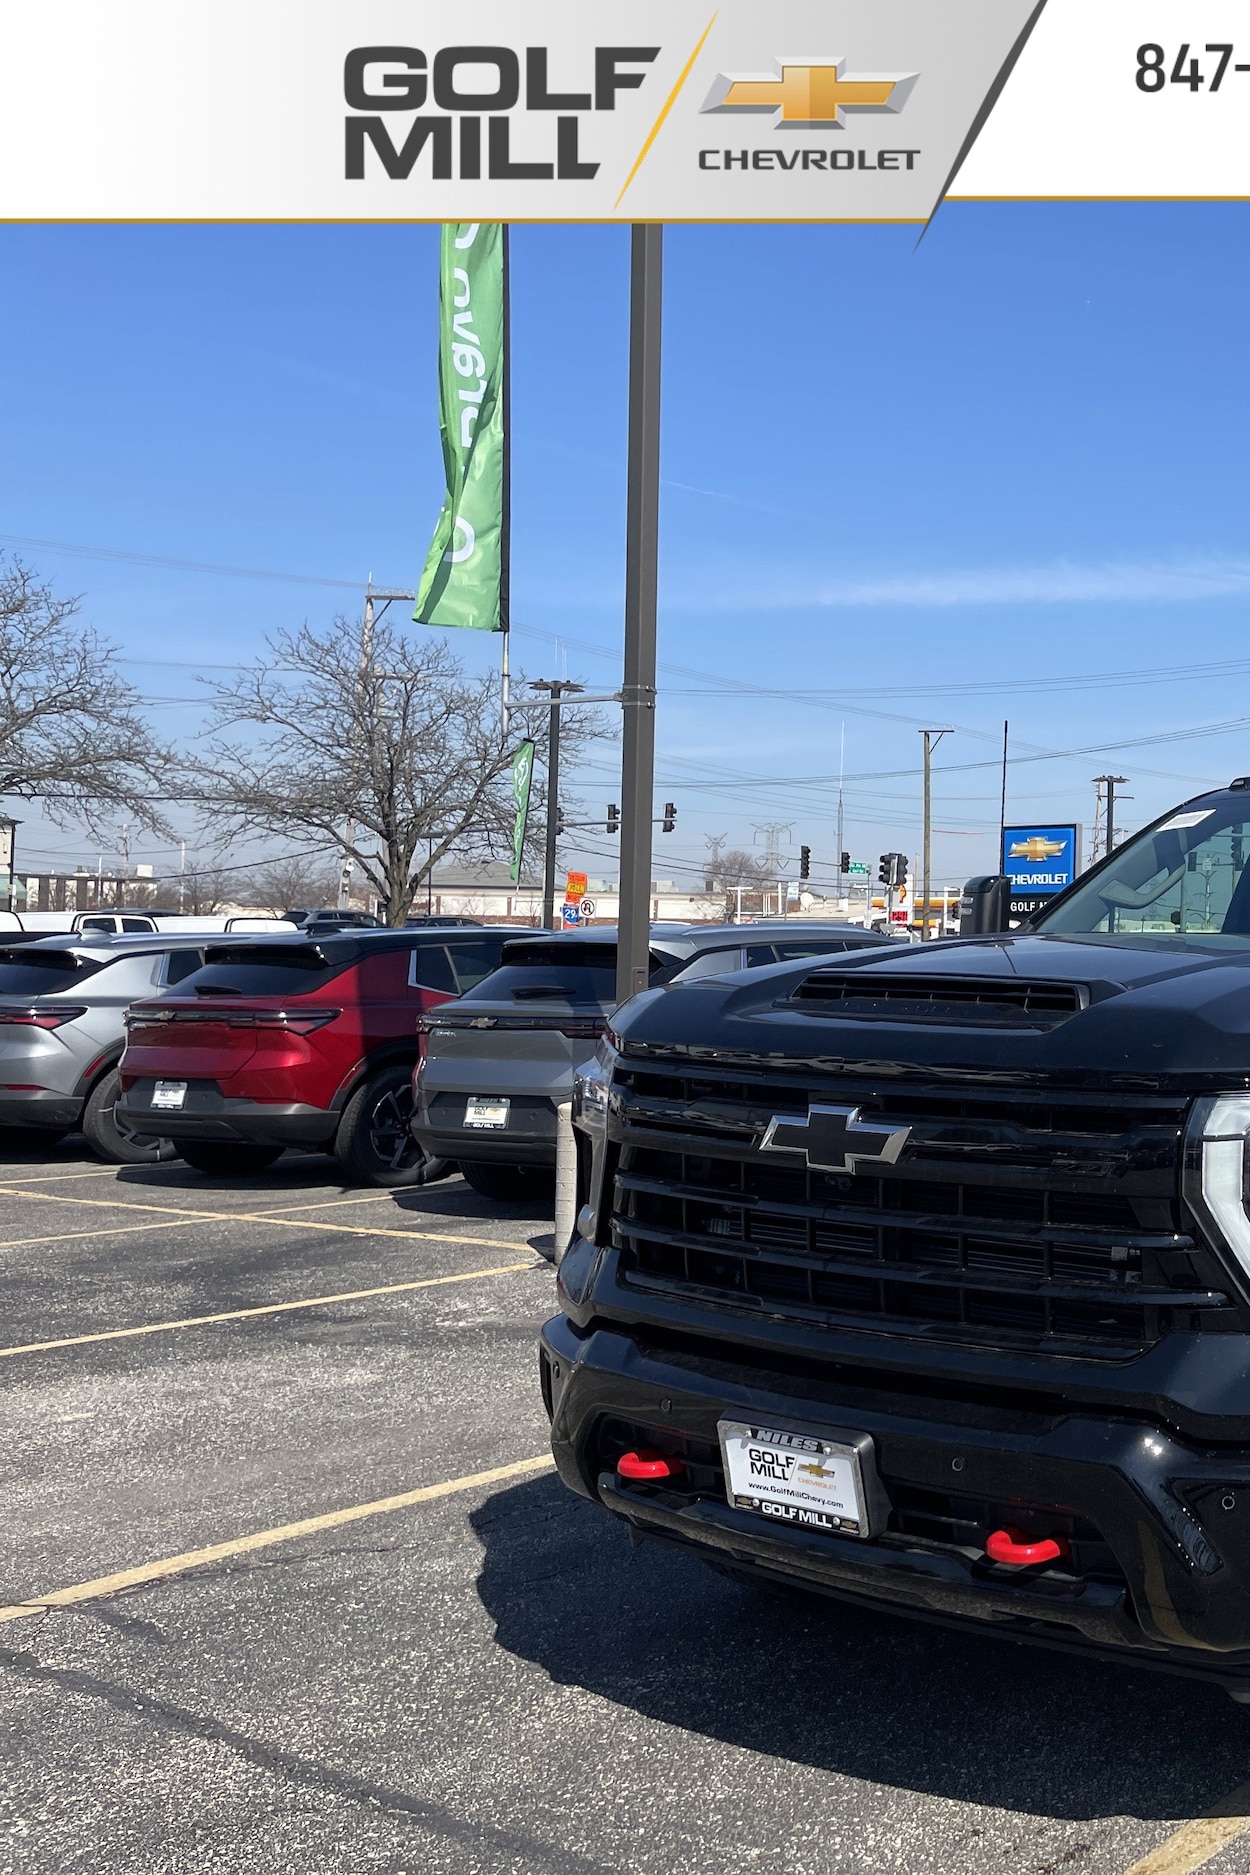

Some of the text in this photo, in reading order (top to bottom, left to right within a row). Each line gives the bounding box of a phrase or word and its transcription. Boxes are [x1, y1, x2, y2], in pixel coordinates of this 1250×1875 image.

[1006, 873, 1068, 885] CHEVROLET
[565, 908, 578, 919] 29
[1010, 901, 1035, 912] GOLF
[757, 1430, 818, 1452] NILES
[749, 1448, 795, 1469] GOLF
[750, 1461, 789, 1481] MILL
[748, 1482, 844, 1509] www.GolfMillChevy.com
[761, 1501, 832, 1528] GOLF MILL
